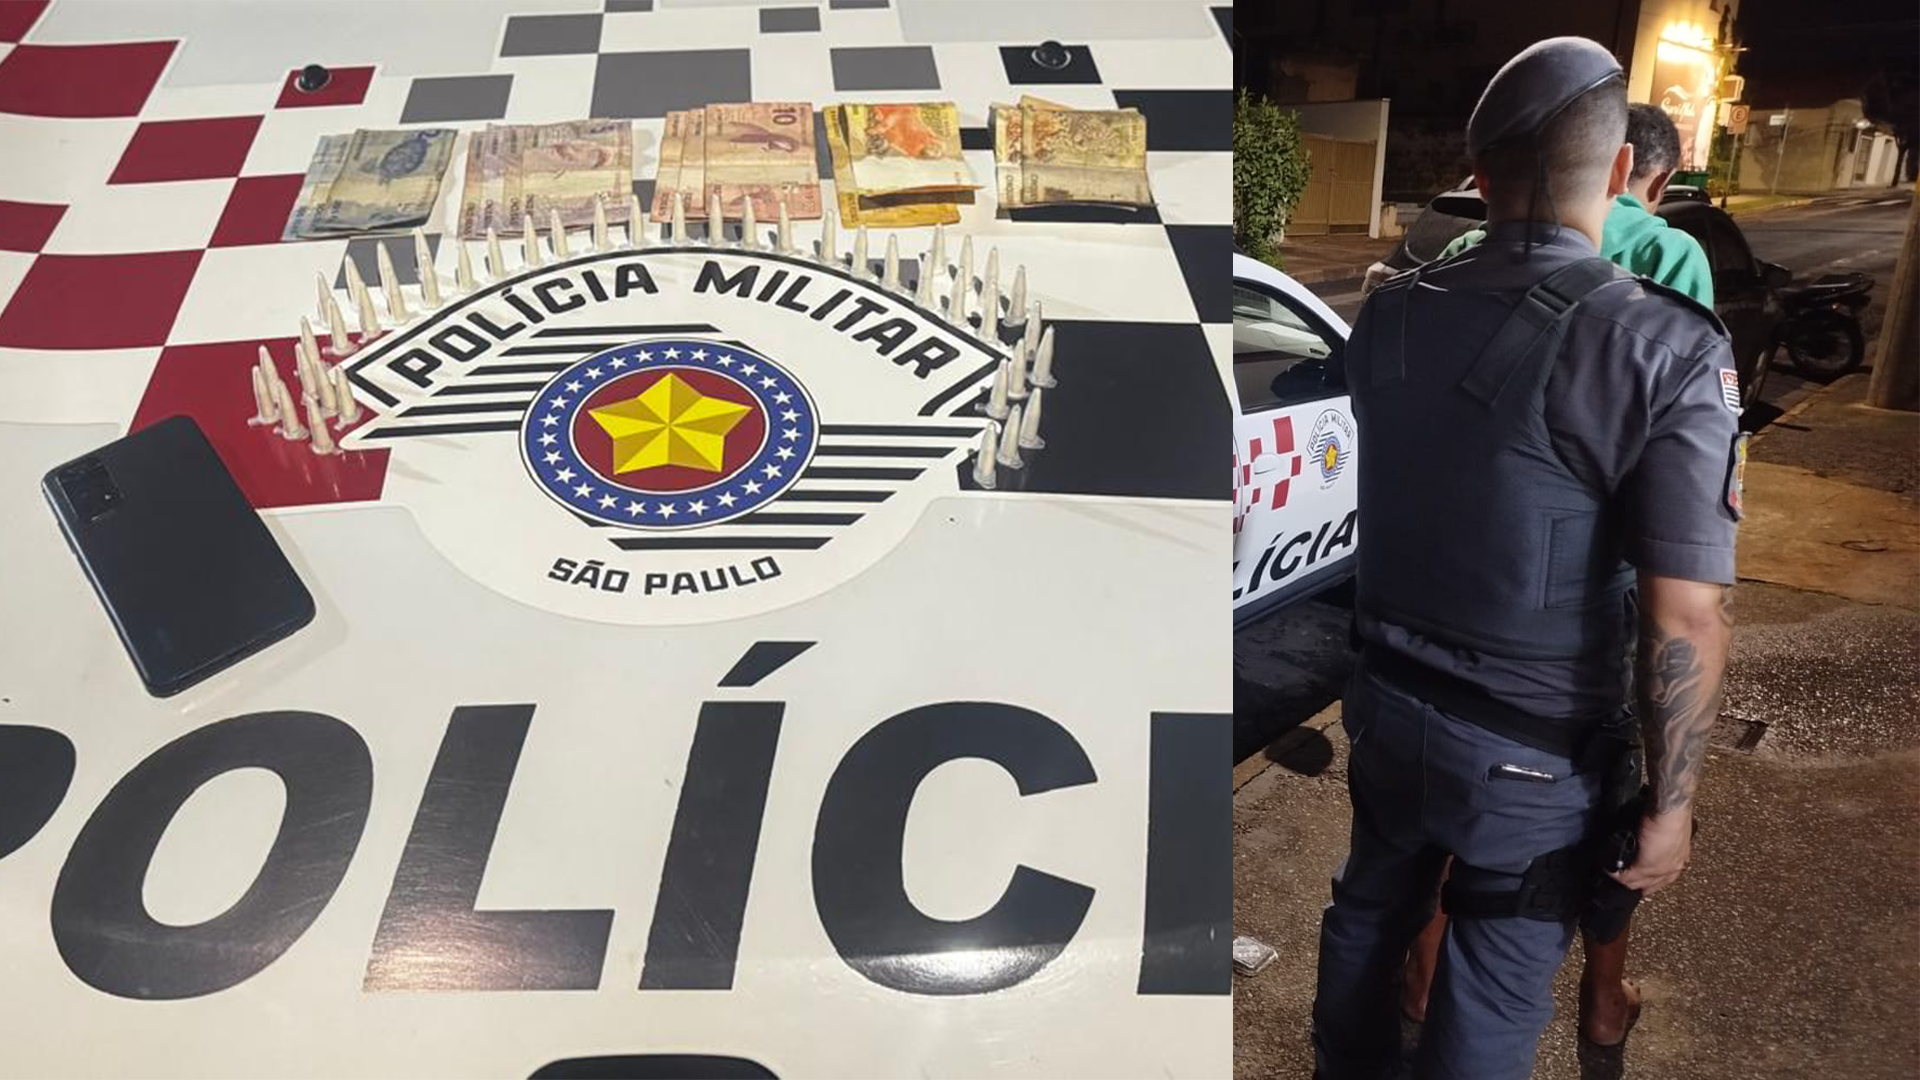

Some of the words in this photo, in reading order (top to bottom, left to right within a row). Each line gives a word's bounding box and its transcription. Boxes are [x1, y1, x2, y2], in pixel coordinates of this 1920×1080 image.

[772, 107, 797, 125] 10
[387, 263, 659, 388] POLÍCIA
[693, 261, 960, 379] MILITAR
[548, 557, 629, 593] SÃO
[644, 556, 781, 595] PAULO
[0, 641, 1232, 1000] OLÍCI
